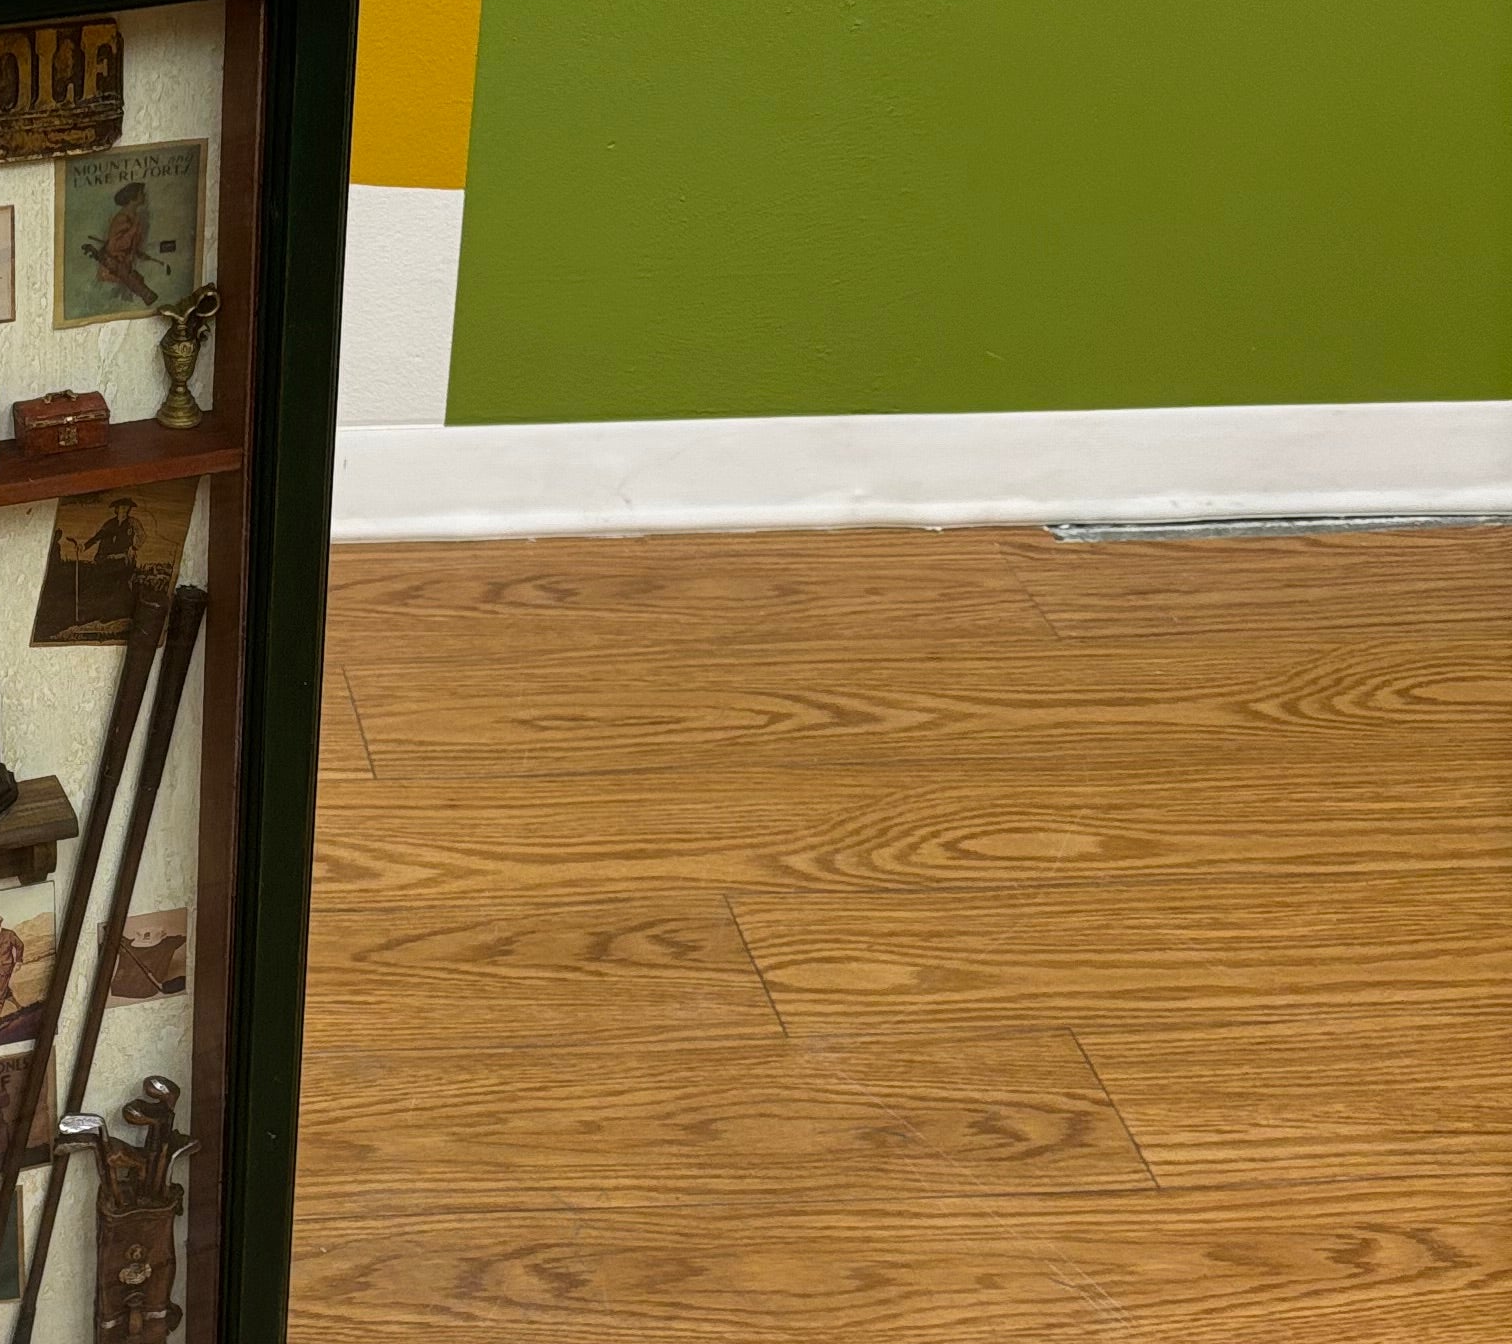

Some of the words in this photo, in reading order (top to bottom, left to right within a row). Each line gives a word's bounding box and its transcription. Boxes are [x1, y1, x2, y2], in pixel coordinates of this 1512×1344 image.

[73, 155, 160, 177] MOUNTAIN
[73, 172, 113, 188] LAKE
[119, 163, 192, 182] RESORTS
